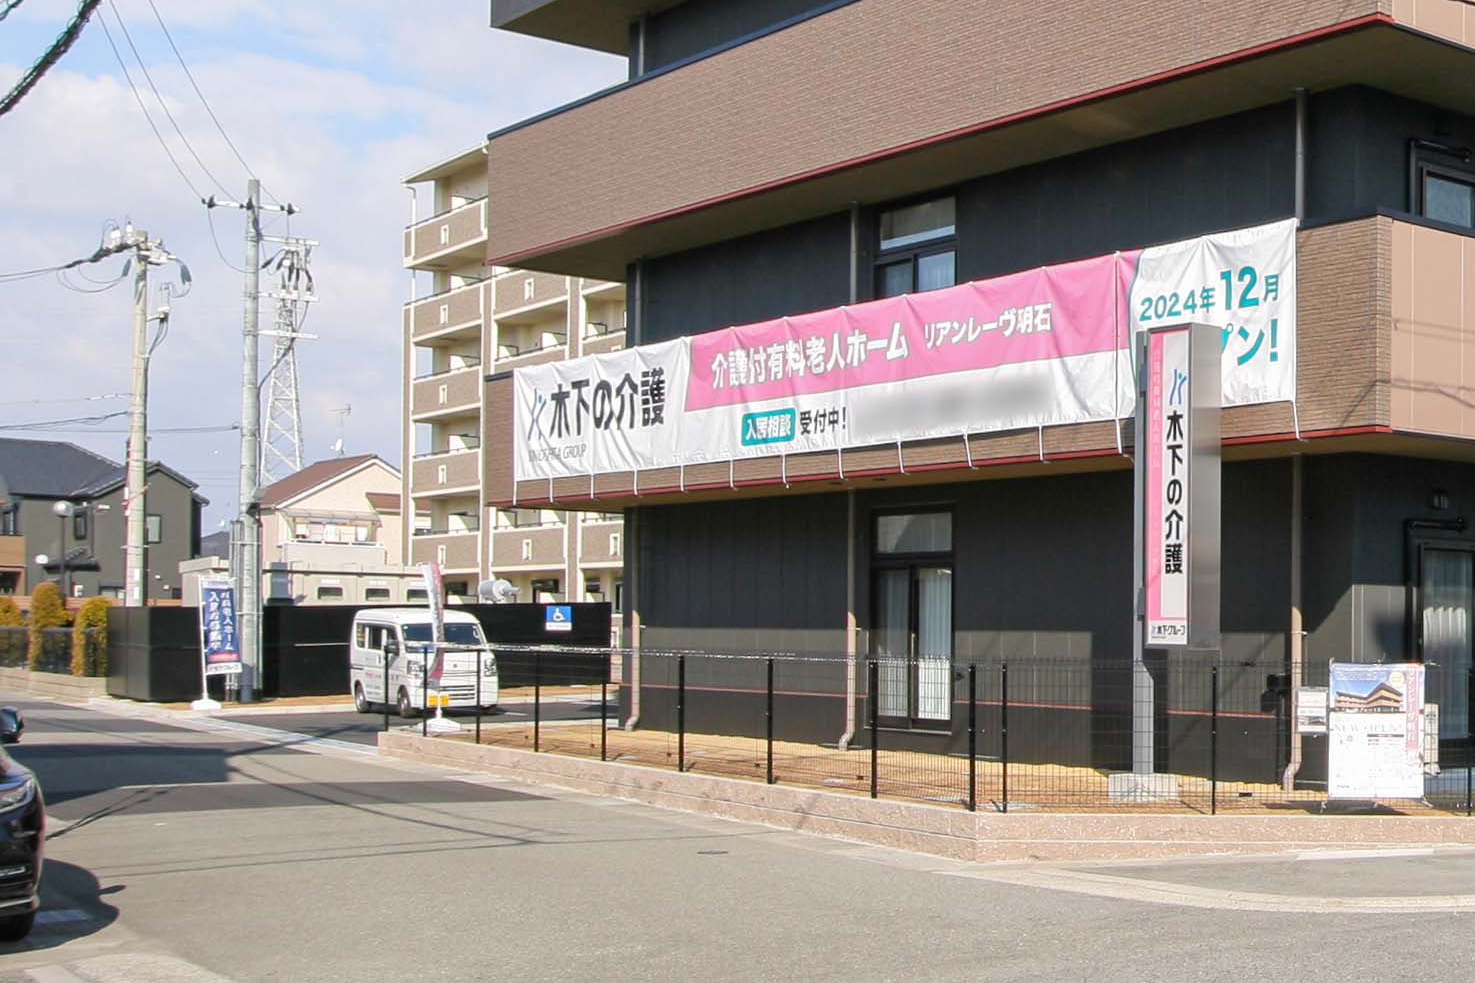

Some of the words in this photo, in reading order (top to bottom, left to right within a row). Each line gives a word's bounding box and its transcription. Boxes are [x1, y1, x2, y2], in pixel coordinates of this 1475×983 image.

[711, 322, 909, 390] 介護付有料老人ホーム
[924, 303, 1053, 350] リアンレーヴ明石
[549, 367, 666, 438] 木下の介護
[746, 414, 792, 440] 入居相談
[799, 406, 847, 435] 受付中!
[1165, 410, 1184, 574] 木下の介護
